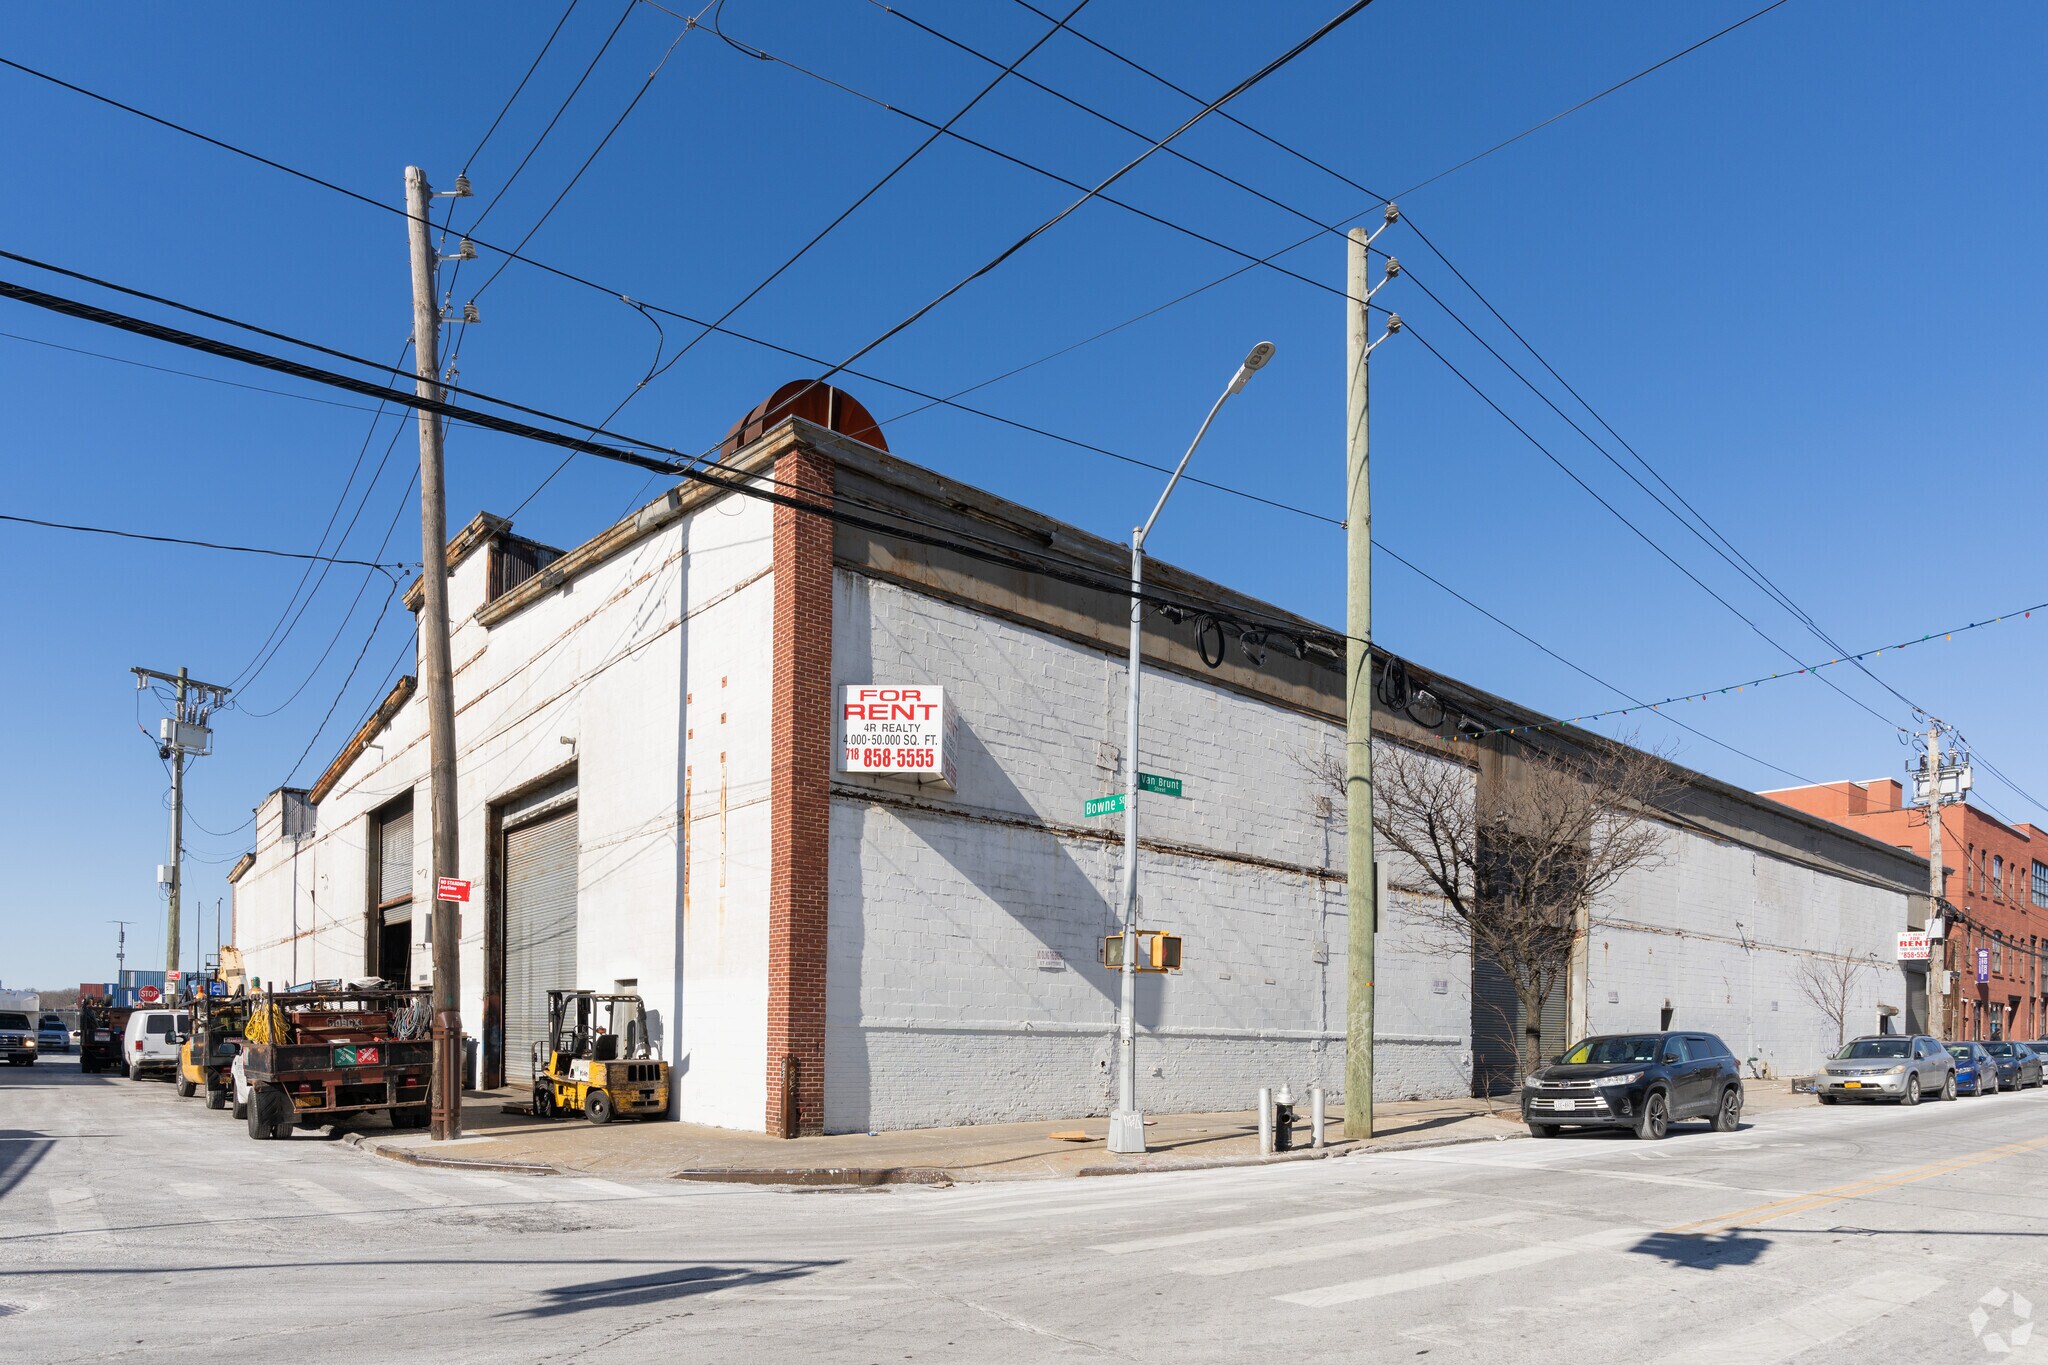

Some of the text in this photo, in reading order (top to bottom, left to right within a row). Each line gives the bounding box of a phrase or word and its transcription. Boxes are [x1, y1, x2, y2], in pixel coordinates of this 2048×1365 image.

[860, 690, 921, 701] FOR
[844, 704, 938, 720] RENT
[864, 723, 921, 733] 4R REALTY
[903, 734, 920, 746] SQ.
[924, 735, 938, 746] FT.
[846, 748, 934, 767] 718 858-5555
[1141, 774, 1179, 789] Van Brunt
[1086, 796, 1125, 815] Bowne St
[141, 990, 158, 998] STOP
